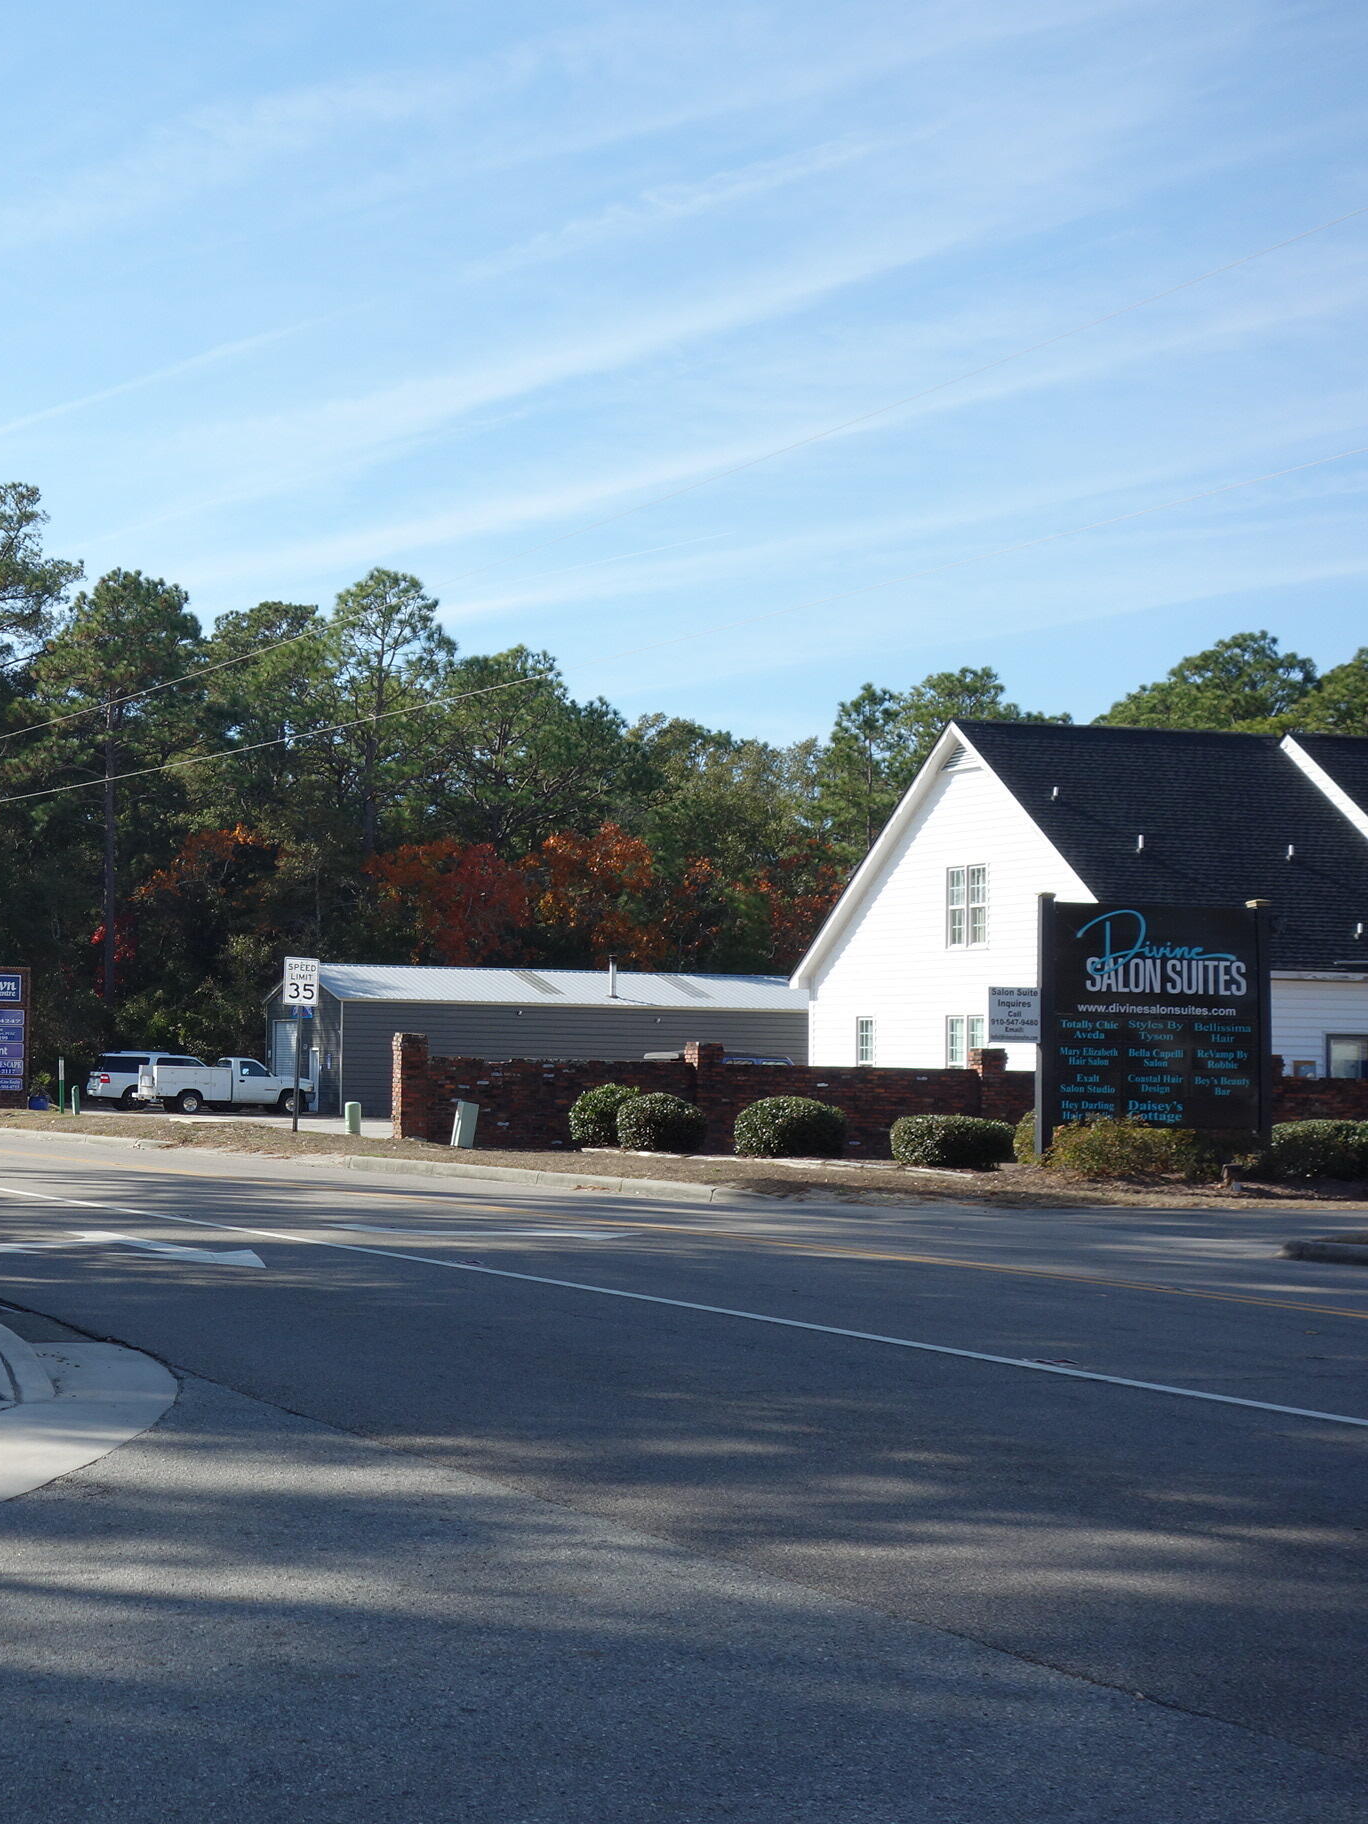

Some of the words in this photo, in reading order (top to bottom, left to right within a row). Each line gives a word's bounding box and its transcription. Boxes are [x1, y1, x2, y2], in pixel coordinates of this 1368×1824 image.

[1076, 909, 1237, 976] Divine
[288, 964, 317, 972] SPEED
[1086, 956, 1162, 994] SALON
[1166, 958, 1247, 996] SUITES
[288, 982, 314, 1000] 35
[992, 988, 1014, 996] Salon
[998, 1000, 1032, 1008] Inquires
[1008, 1010, 1022, 1018] Call
[1078, 1004, 1236, 1016] www.divinesalonsuites.com
[1060, 1020, 1093, 1029] Totally
[1096, 1020, 1119, 1029] Chic
[1128, 1020, 1164, 1030] Styles
[1168, 1021, 1183, 1030] By
[1194, 1022, 1251, 1032] Bellissima
[1074, 1030, 1105, 1039] Aveda
[1139, 1032, 1173, 1041] Tyson
[1212, 1034, 1234, 1042] Hair
[1060, 1047, 1080, 1058] Mary
[1083, 1048, 1118, 1056] Elizabeth
[1129, 1048, 1150, 1057] Bella
[1153, 1048, 1184, 1058] Capelli
[1197, 1050, 1234, 1060] ReVamp
[1236, 1050, 1248, 1060] By
[1068, 1057, 1086, 1065] Hair
[1088, 1057, 1109, 1066] Salon
[1144, 1059, 1168, 1068] Salon
[1208, 1061, 1239, 1070] Robbie
[1076, 1074, 1099, 1082] Exalt
[1128, 1074, 1160, 1082] Coastal
[1163, 1074, 1184, 1083] Hair
[1220, 1076, 1250, 1088] Beauty
[1060, 1084, 1084, 1092] Salon
[1088, 1085, 1115, 1093] Studio
[1142, 1084, 1170, 1094] Design
[1214, 1087, 1230, 1096] Bar
[1062, 1101, 1078, 1110] Hey
[1081, 1101, 1114, 1110] Darling
[1128, 1100, 1184, 1112] Daisey's
